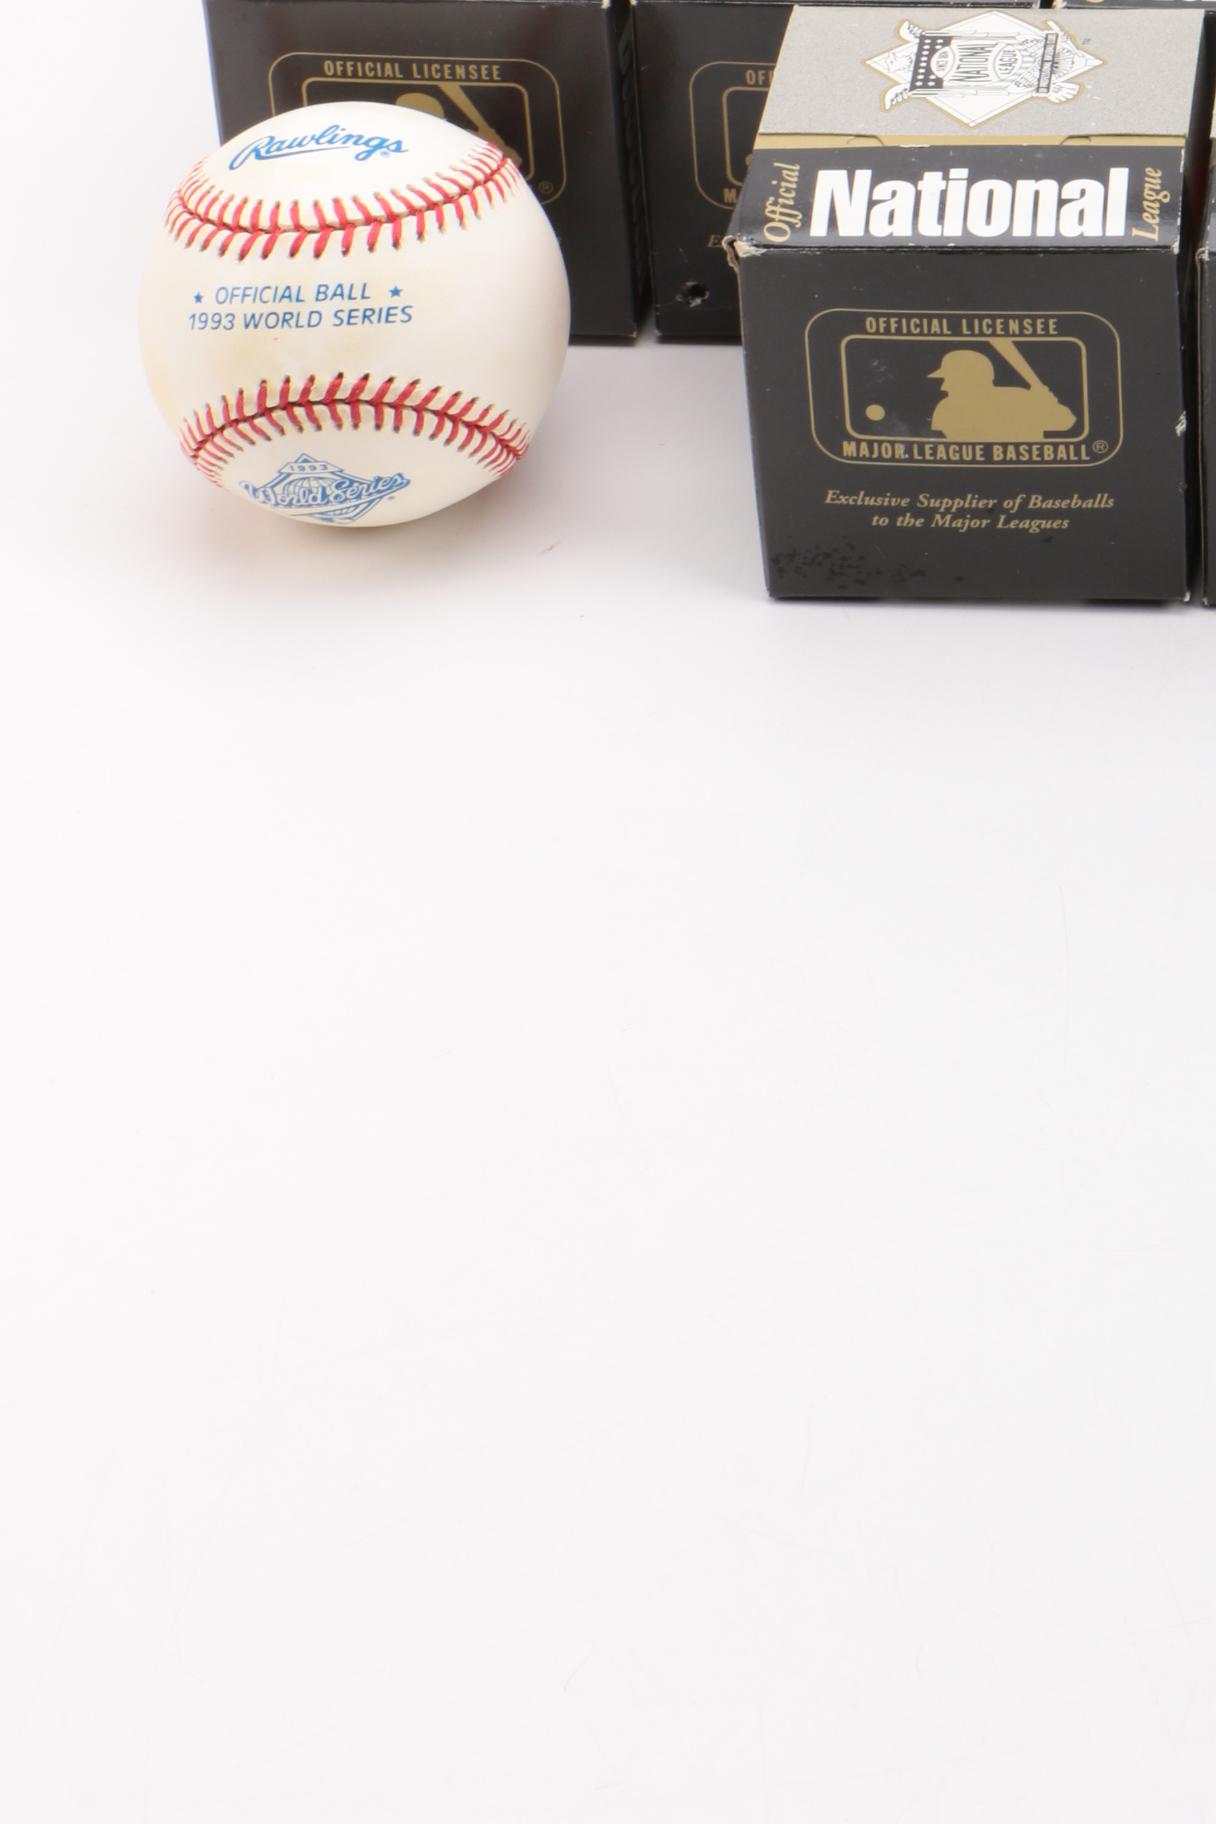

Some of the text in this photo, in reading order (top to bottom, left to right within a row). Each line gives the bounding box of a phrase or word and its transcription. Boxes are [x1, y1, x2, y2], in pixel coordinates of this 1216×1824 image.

[323, 60, 502, 81] OFFICIAL LICENSEE
[228, 124, 409, 171] Rawlings
[764, 162, 1172, 243] Official National League
[214, 282, 371, 305] OFFICIAL BALL
[188, 305, 414, 331] 1993 WORLD SERIES
[865, 317, 1058, 337] OFFICIAL LICENSEE
[843, 440, 905, 459] MAJOR
[913, 443, 985, 462] LEAGUE
[329, 472, 411, 504] Series
[824, 489, 1115, 516] Exclusive Supplier of Baseballs
[871, 512, 1069, 535] to the Major Leagues
